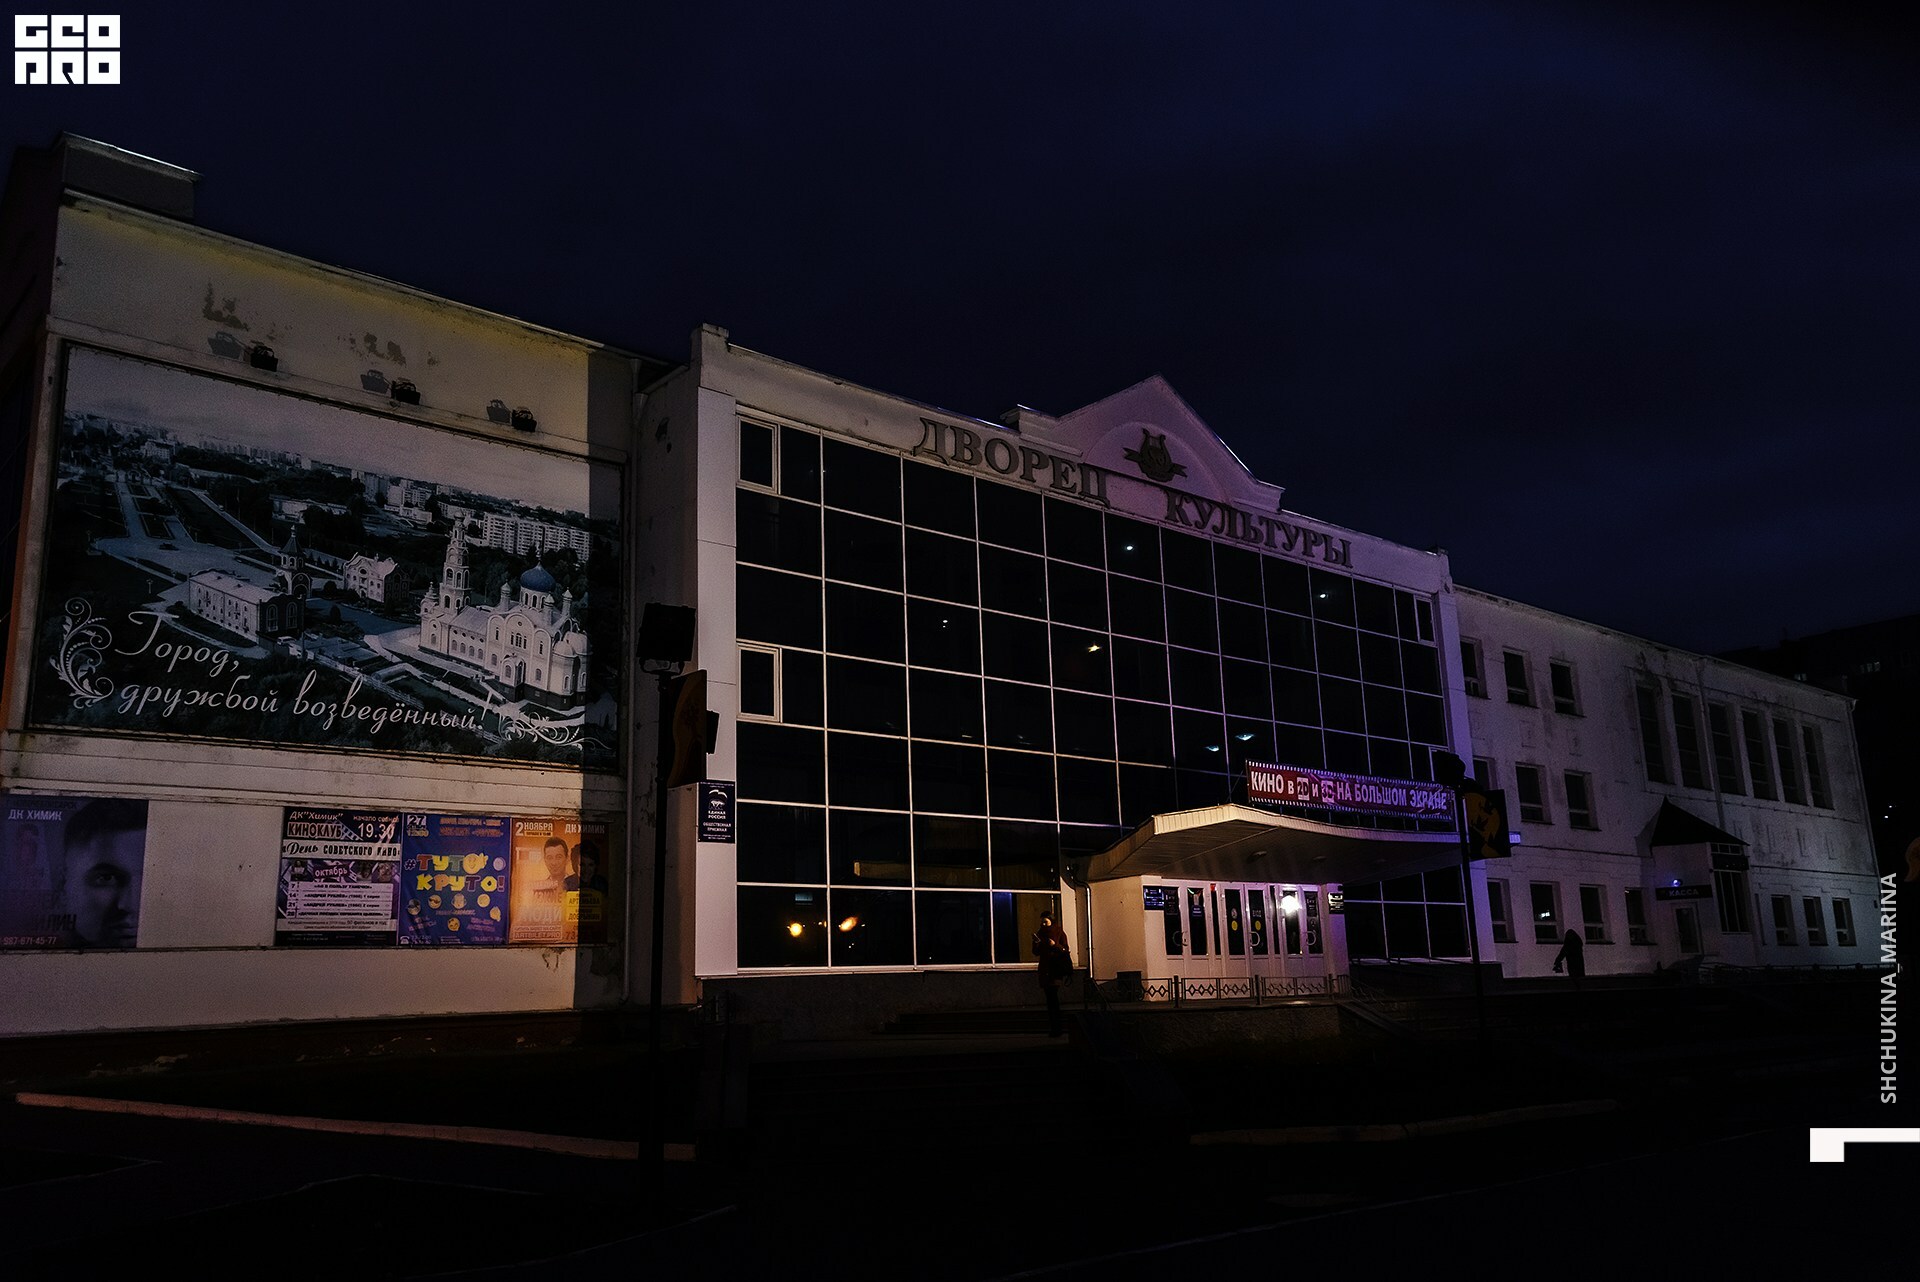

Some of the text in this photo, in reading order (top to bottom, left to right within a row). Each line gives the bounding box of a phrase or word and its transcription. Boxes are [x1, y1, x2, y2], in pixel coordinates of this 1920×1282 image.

[913, 416, 1353, 568] ДВОРЕЦ КУЛЬТУРЫ
[114, 610, 241, 678] Город,
[118, 669, 493, 735] дружбой возведённый!
[1251, 770, 1284, 794] КИНО
[1297, 779, 1309, 797] 2D
[1337, 781, 1352, 801] НА
[1354, 785, 1408, 807] БОЛЬШОМ
[1409, 789, 1447, 810] ЭКРАНЕ
[8, 808, 62, 821] ДК ХИМИК
[408, 815, 425, 825] 27
[288, 822, 341, 837] КИНОКЛУБ
[516, 822, 524, 836] 2
[524, 822, 553, 831] НОЯБРЯ
[577, 824, 605, 834] ХИМИК
[323, 845, 372, 856] СОВЕТСКОГО
[315, 866, 347, 878] октябрь
[416, 874, 505, 892] КРУТО!
[1668, 888, 1700, 897] КАССА
